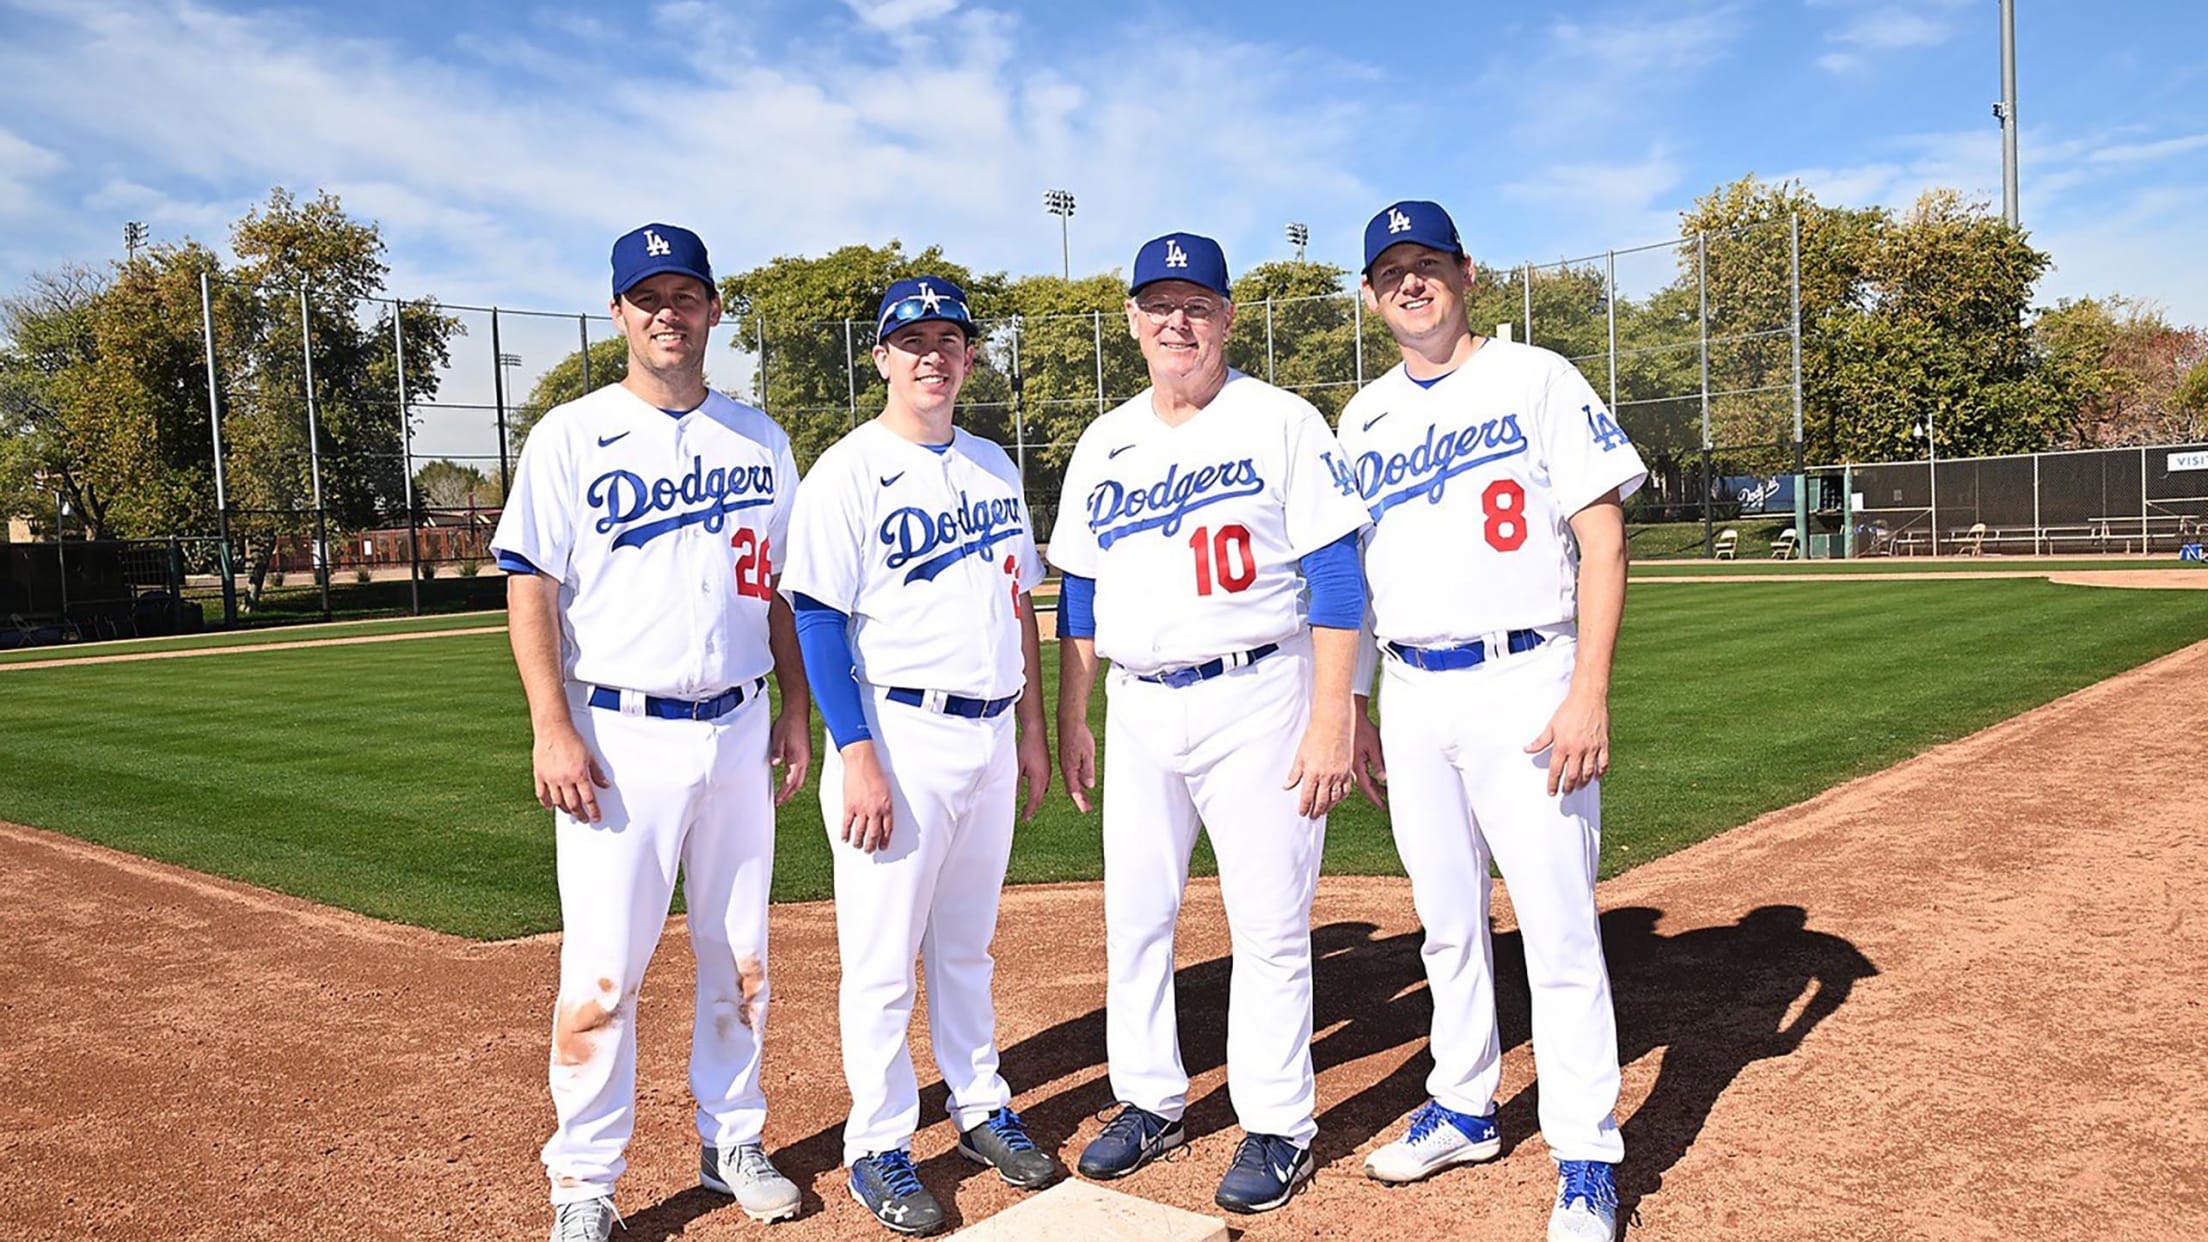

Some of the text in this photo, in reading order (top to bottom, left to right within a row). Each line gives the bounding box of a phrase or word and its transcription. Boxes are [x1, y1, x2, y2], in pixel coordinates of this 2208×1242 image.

[643, 229, 672, 257] LA
[1388, 207, 1412, 235] LA
[1164, 239, 1188, 268] LA
[1581, 404, 1630, 452] LA
[1355, 413, 1529, 504] Dodgers
[2177, 455, 2208, 466] VISI
[587, 454, 774, 535] Dodgers
[1086, 458, 1264, 538] Dodgers
[1482, 478, 1528, 553] 8
[1189, 524, 1257, 597] 10
